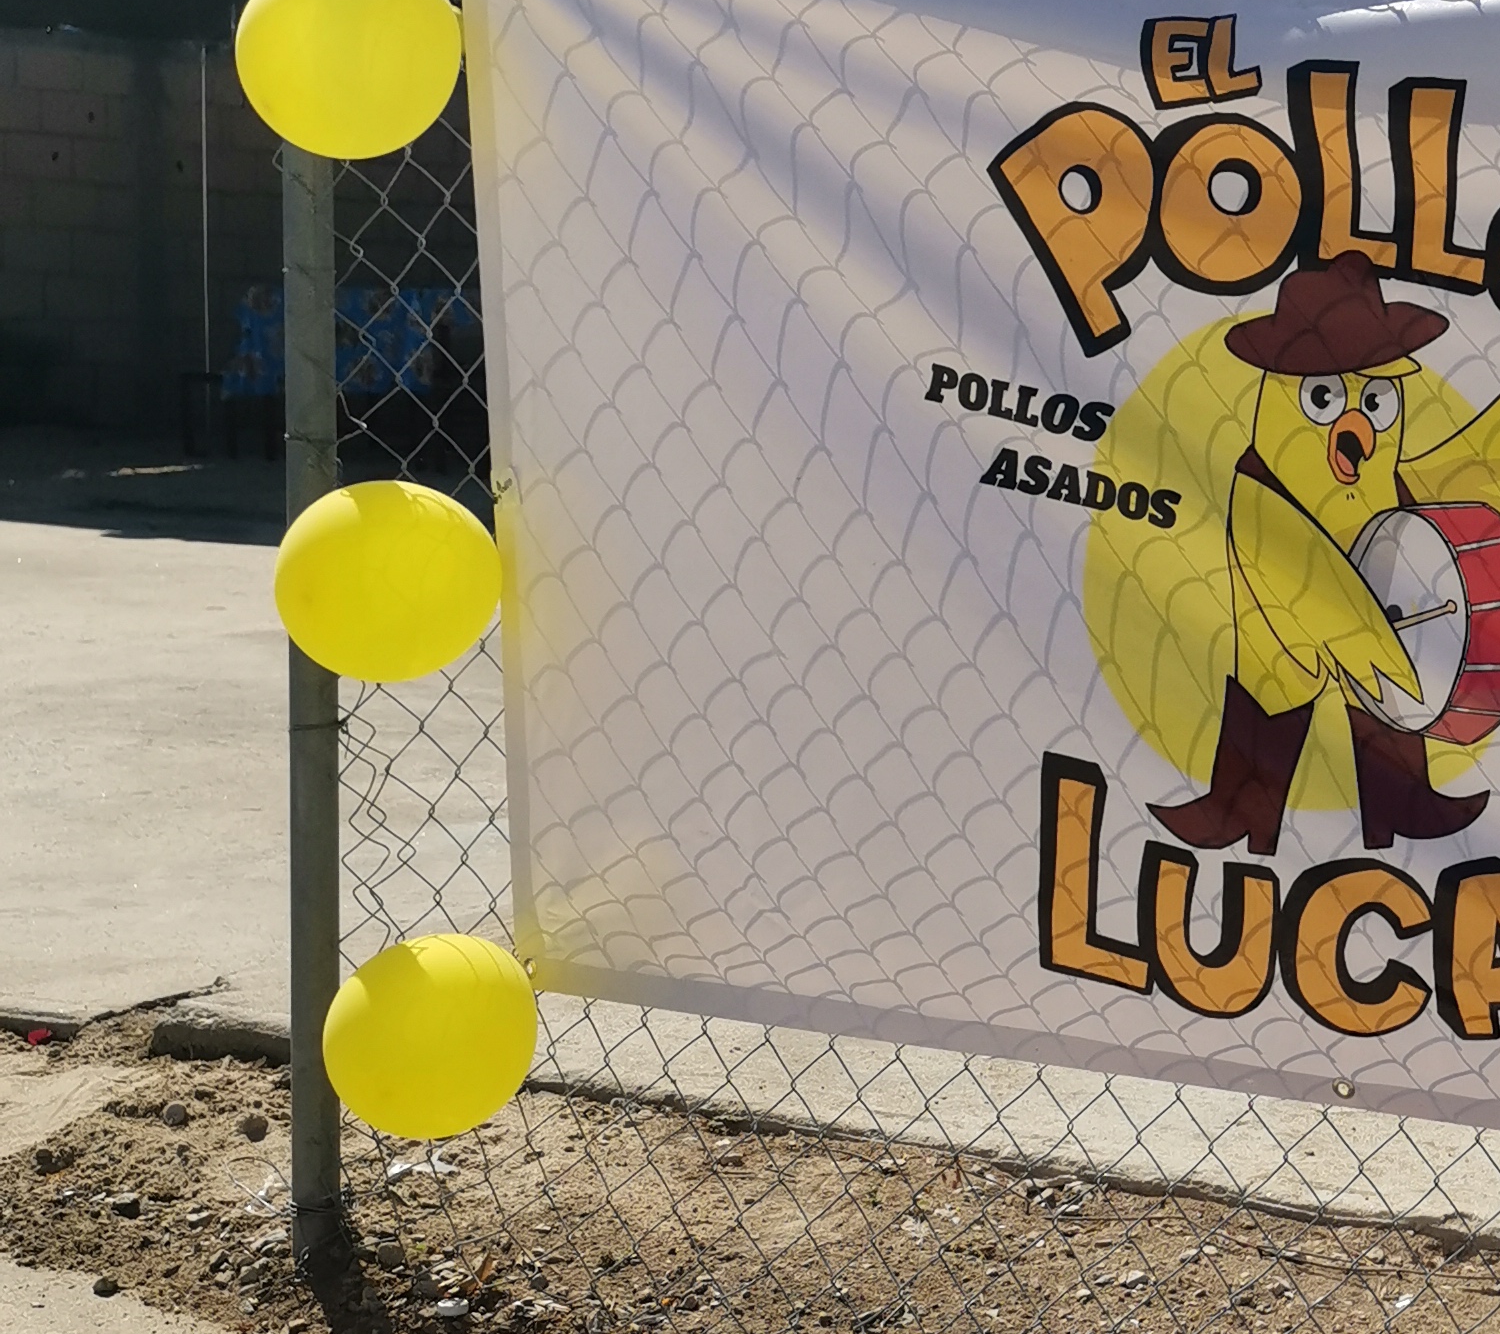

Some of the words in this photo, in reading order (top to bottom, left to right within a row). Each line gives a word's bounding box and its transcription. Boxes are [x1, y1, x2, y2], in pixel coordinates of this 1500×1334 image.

[1139, 13, 1262, 110] EL
[924, 363, 1115, 444] POLLOS
[979, 446, 1183, 531] ASADOS
